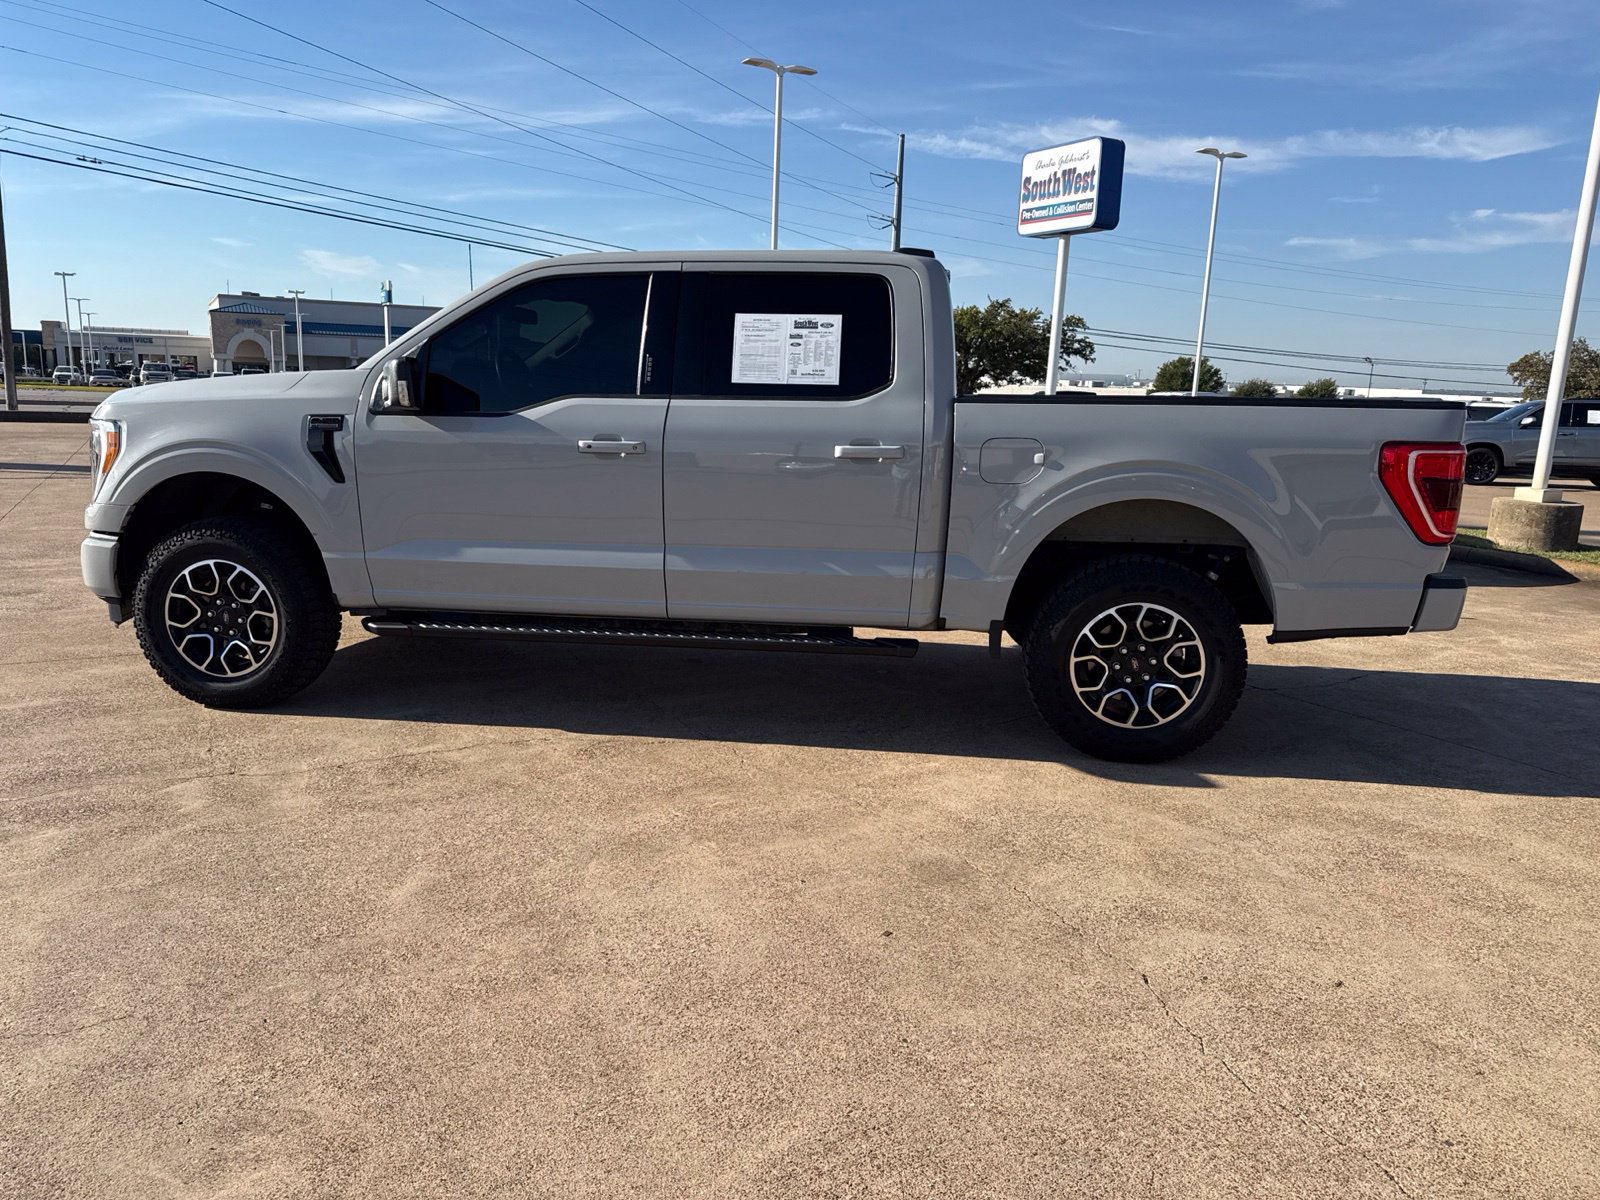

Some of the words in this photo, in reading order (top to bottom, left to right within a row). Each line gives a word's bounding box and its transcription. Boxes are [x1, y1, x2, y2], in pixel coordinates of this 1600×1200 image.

[1022, 164, 1096, 203] SouthWest
[1022, 209, 1049, 220] Pre-Owned
[1053, 204, 1076, 215] Collision
[1076, 202, 1093, 211] Center
